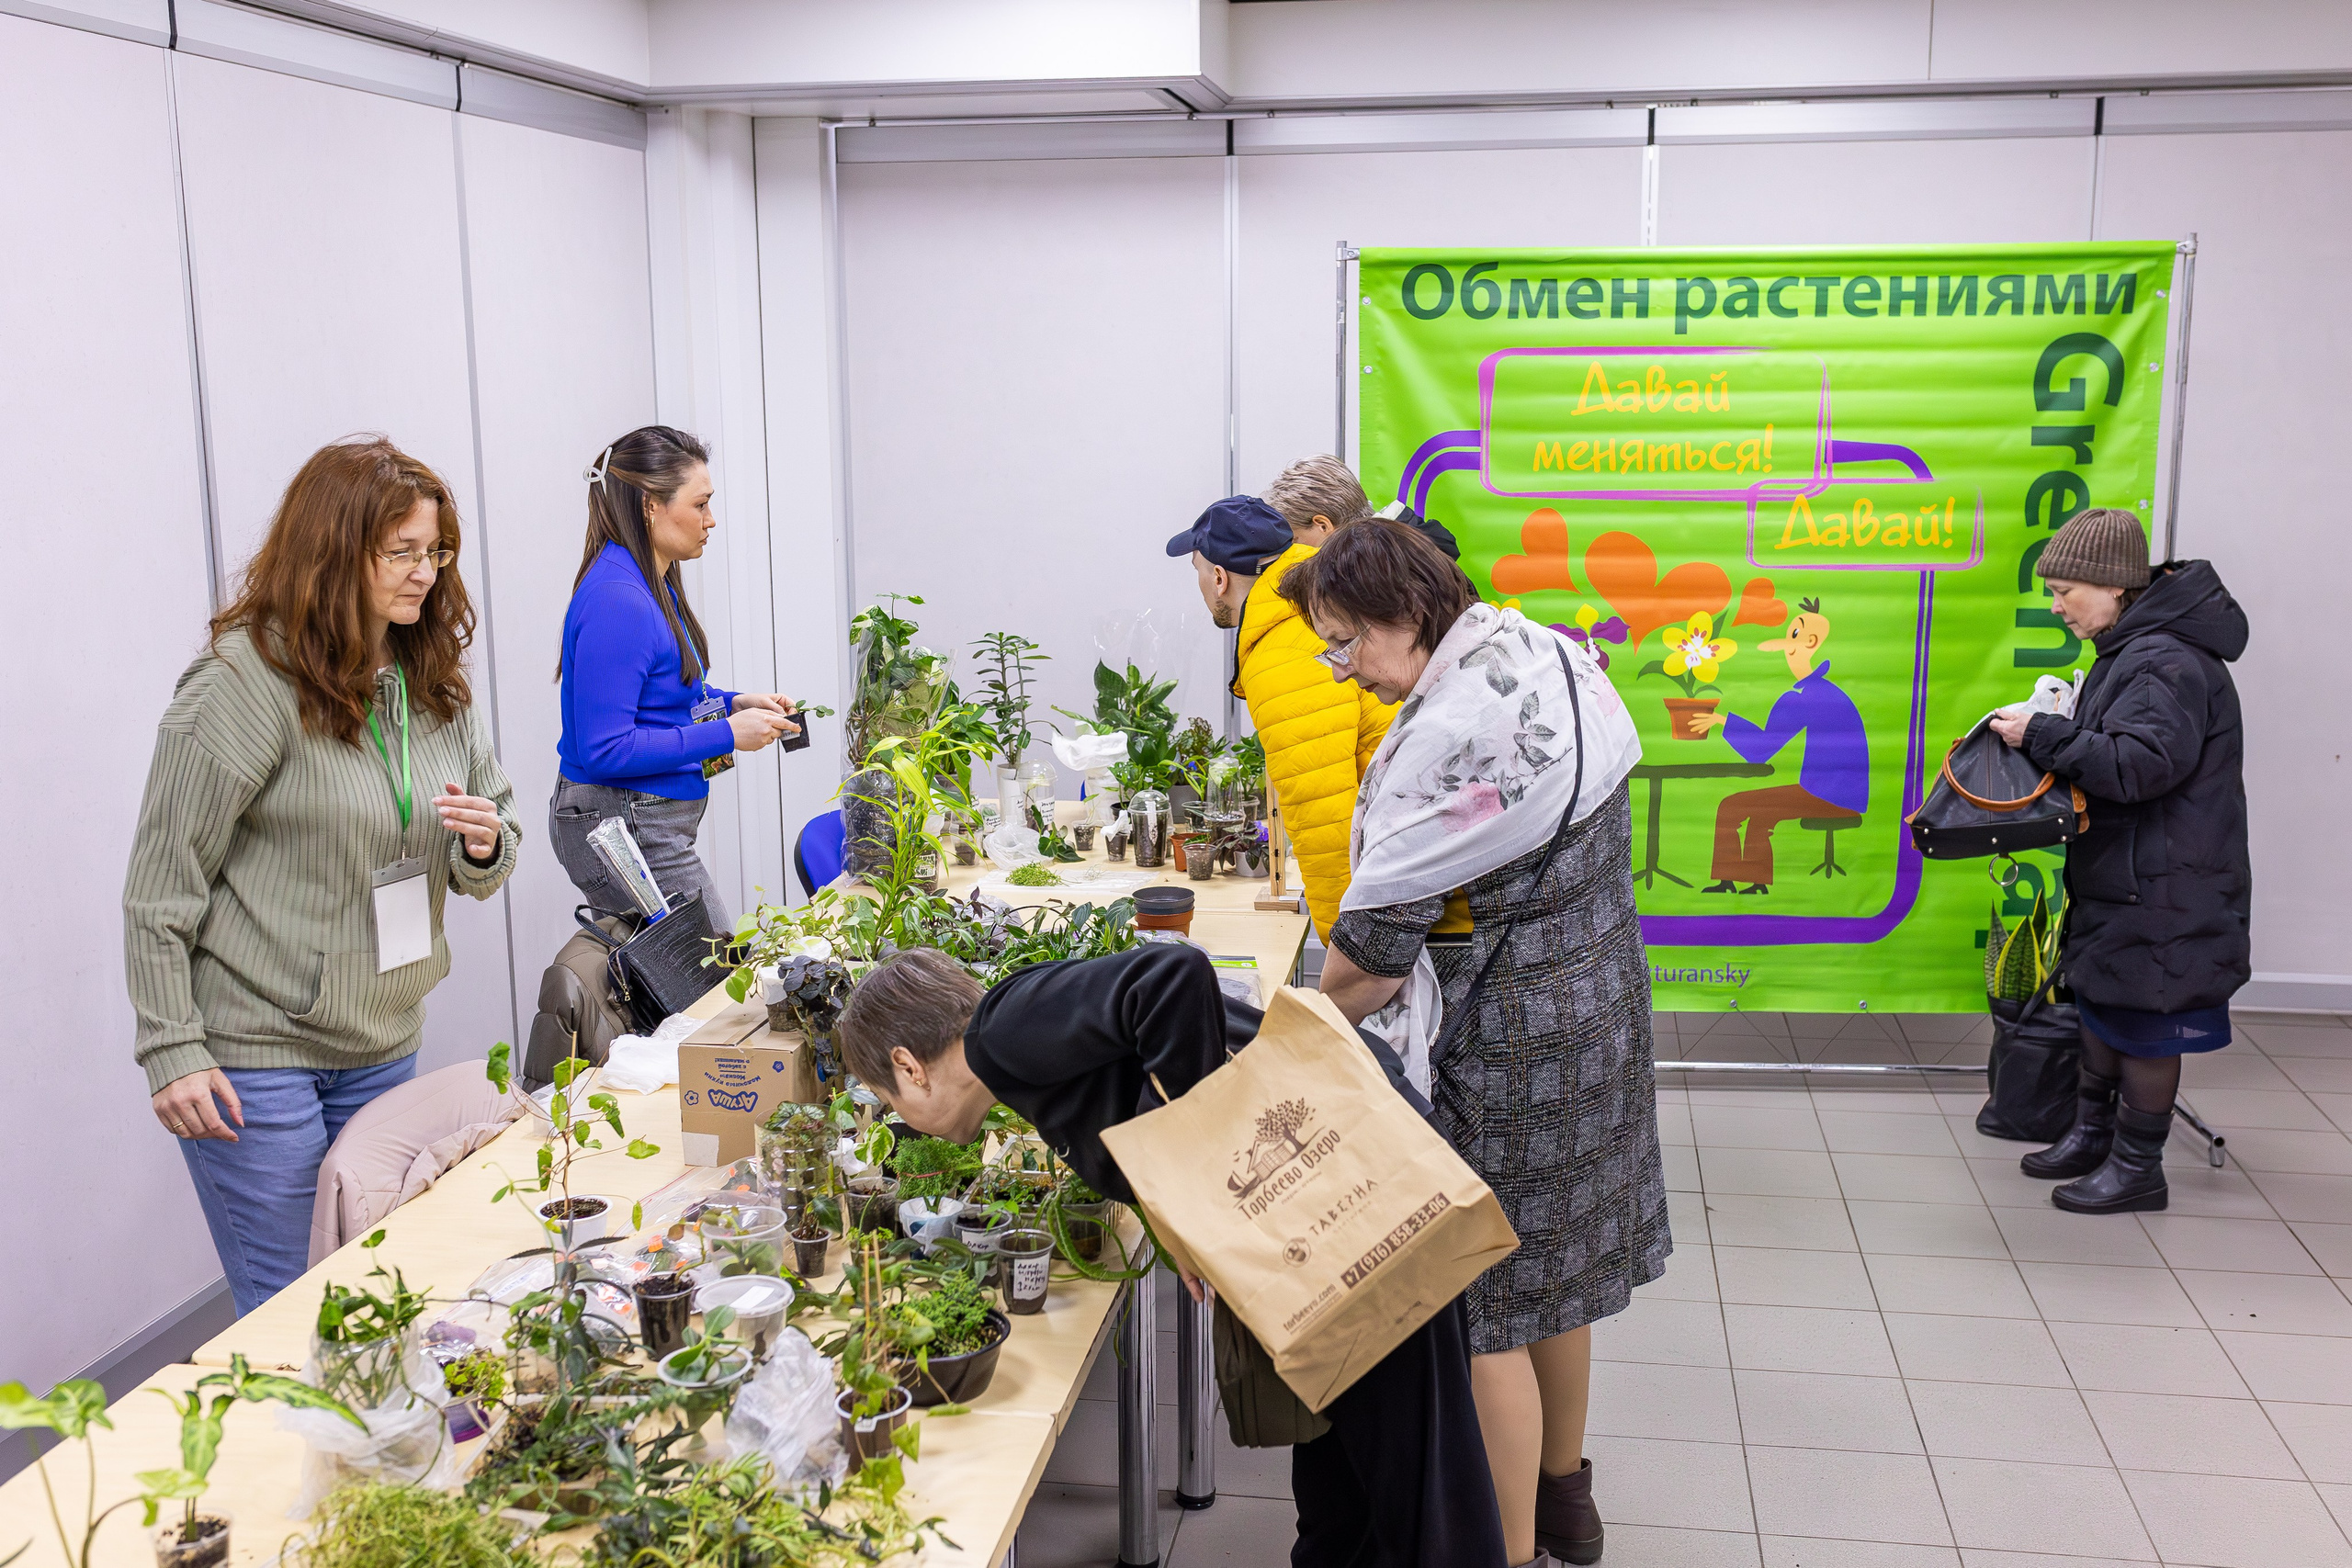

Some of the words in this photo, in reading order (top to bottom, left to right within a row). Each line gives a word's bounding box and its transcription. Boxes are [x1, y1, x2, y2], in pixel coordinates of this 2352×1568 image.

[1402, 262, 1650, 321] Обмен
[1675, 273, 2138, 334] растениями
[1571, 361, 1730, 416] Давай
[1532, 423, 1774, 475] меняться!
[1774, 493, 1955, 550] Давай!
[1648, 963, 1751, 988] turansky
[1238, 1167, 1303, 1220] Торбеево
[1301, 1130, 1340, 1168] Озеро
[1344, 1267, 1362, 1285] +7
[1359, 1240, 1393, 1273] (916)
[1389, 1196, 1447, 1247] 858-33-06
